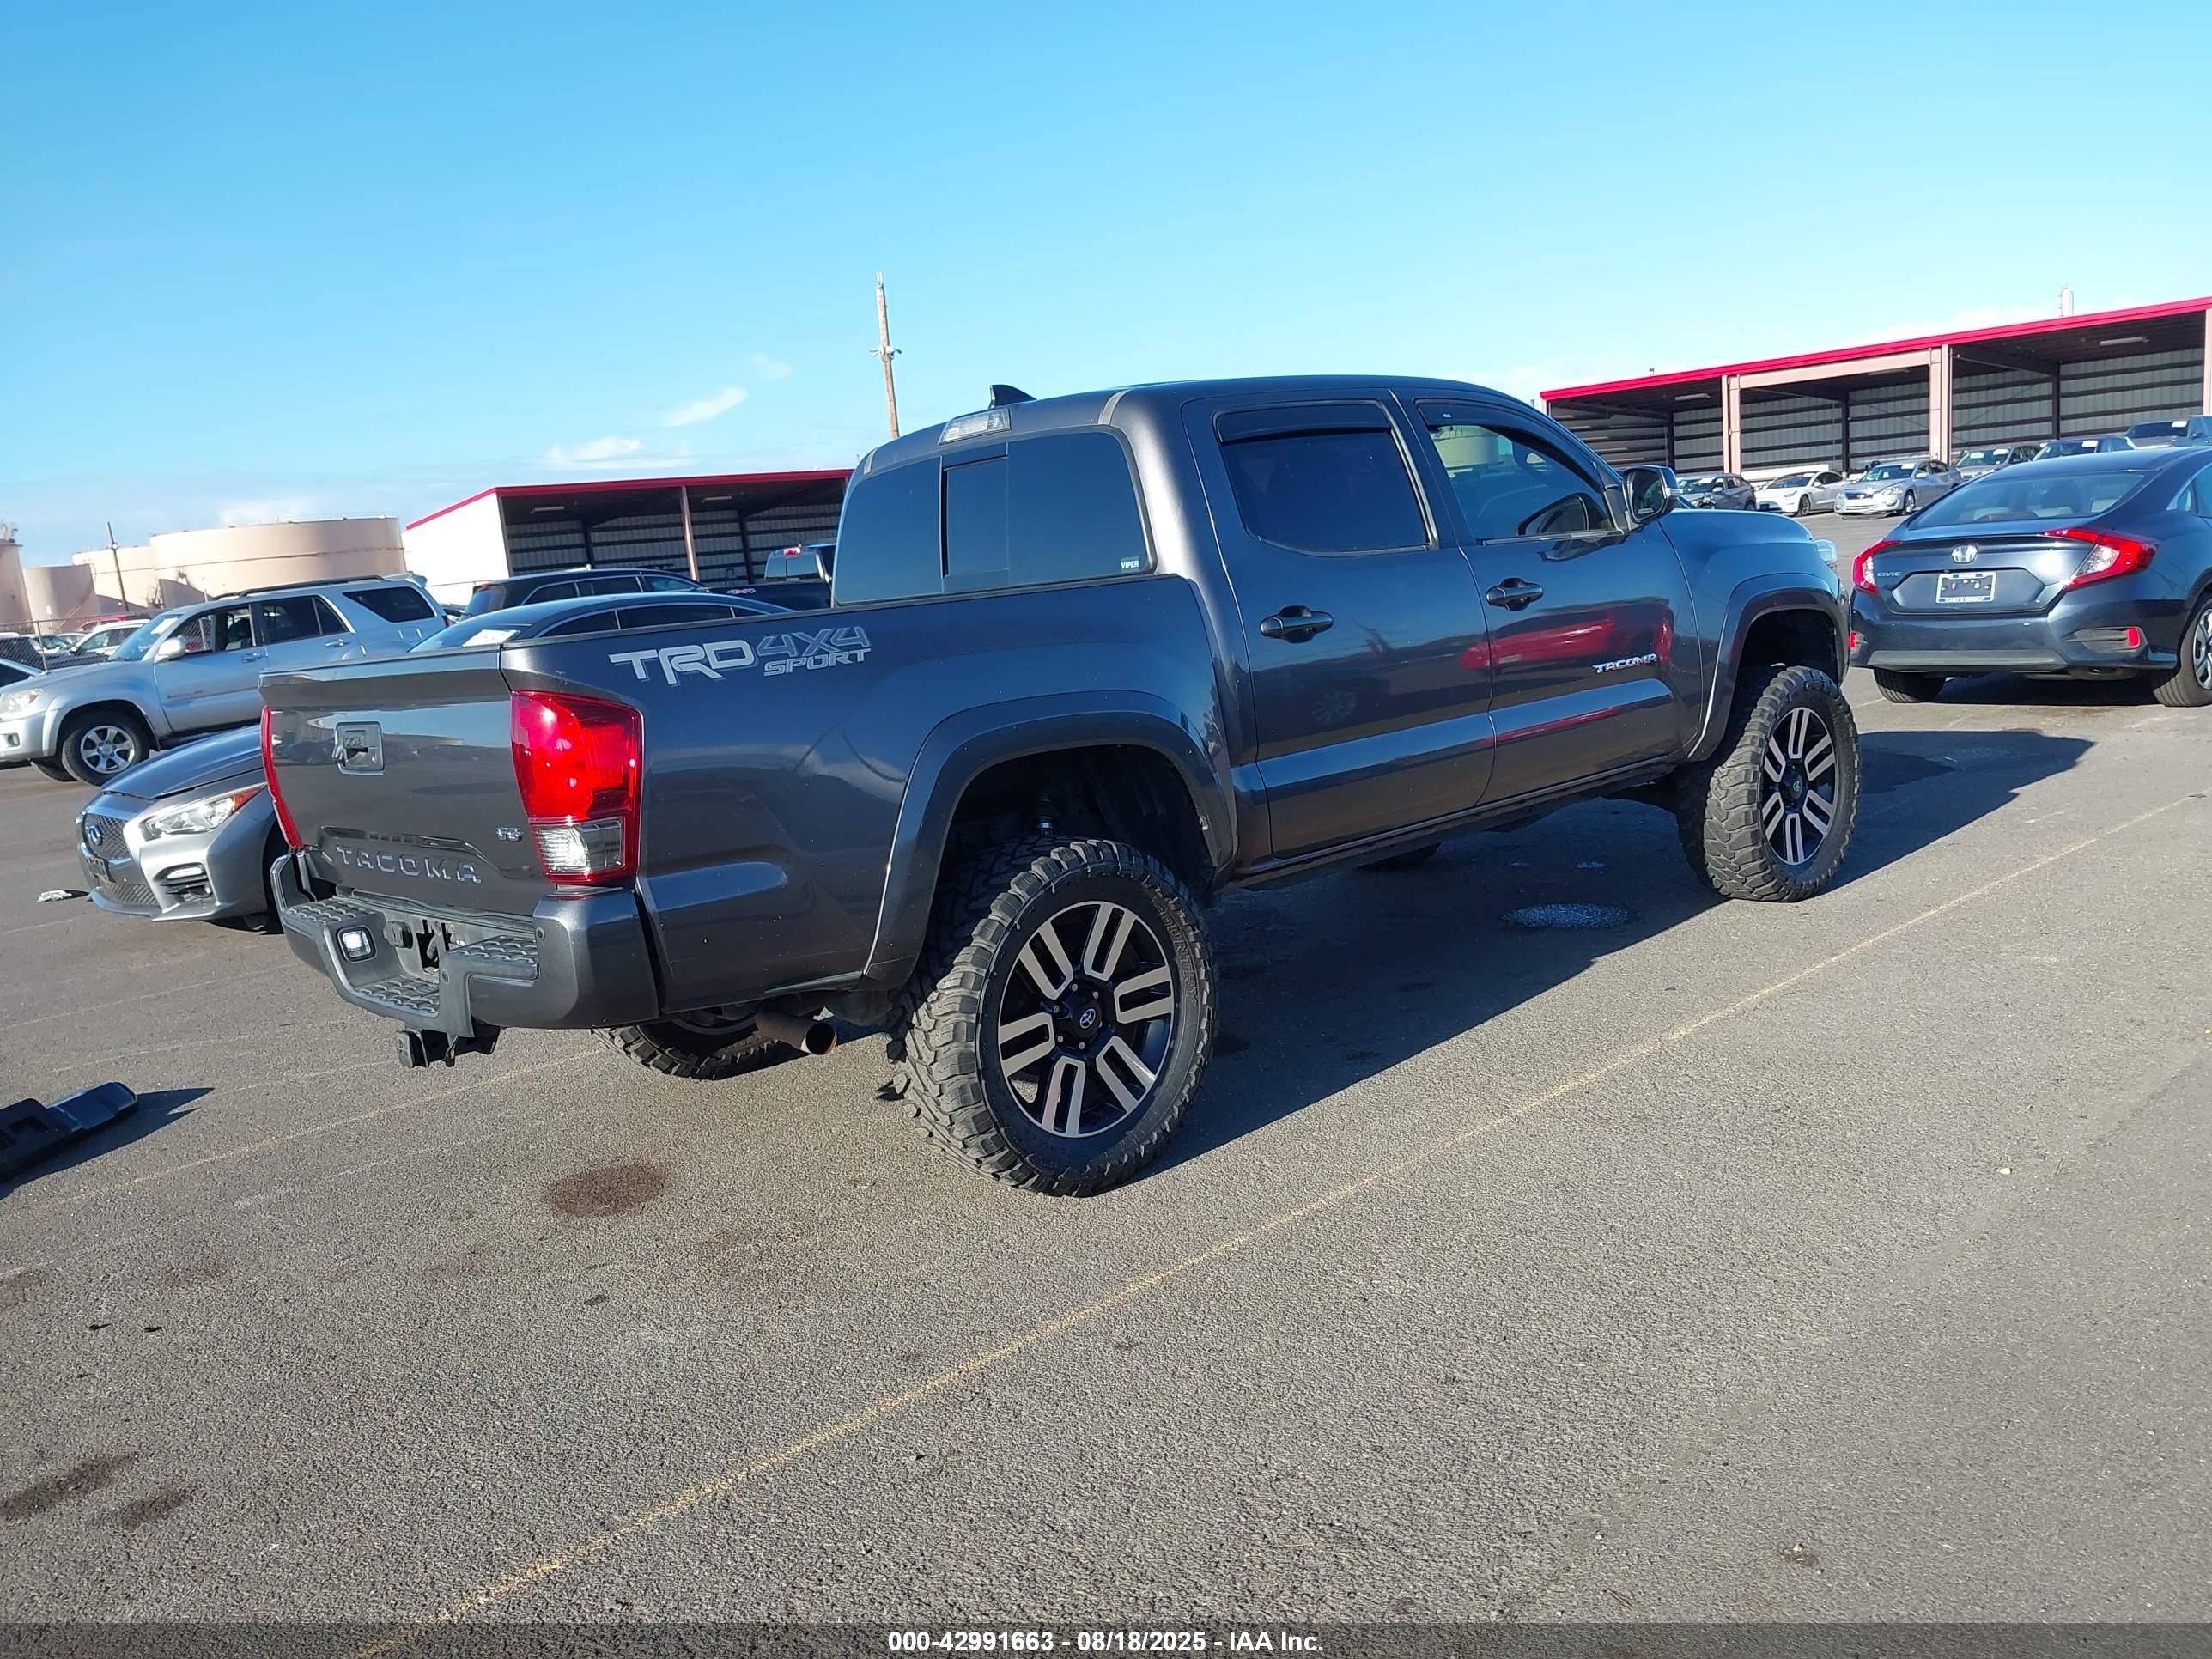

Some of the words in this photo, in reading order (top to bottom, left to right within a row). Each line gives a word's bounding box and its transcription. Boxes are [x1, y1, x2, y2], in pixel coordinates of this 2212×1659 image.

[1121, 560, 1139, 569] VIPER
[608, 639, 757, 685] TRD
[763, 647, 872, 677] SPORT
[1592, 653, 1658, 674] TACOMA
[494, 826, 522, 842] V6
[336, 845, 482, 884] TACOMA
